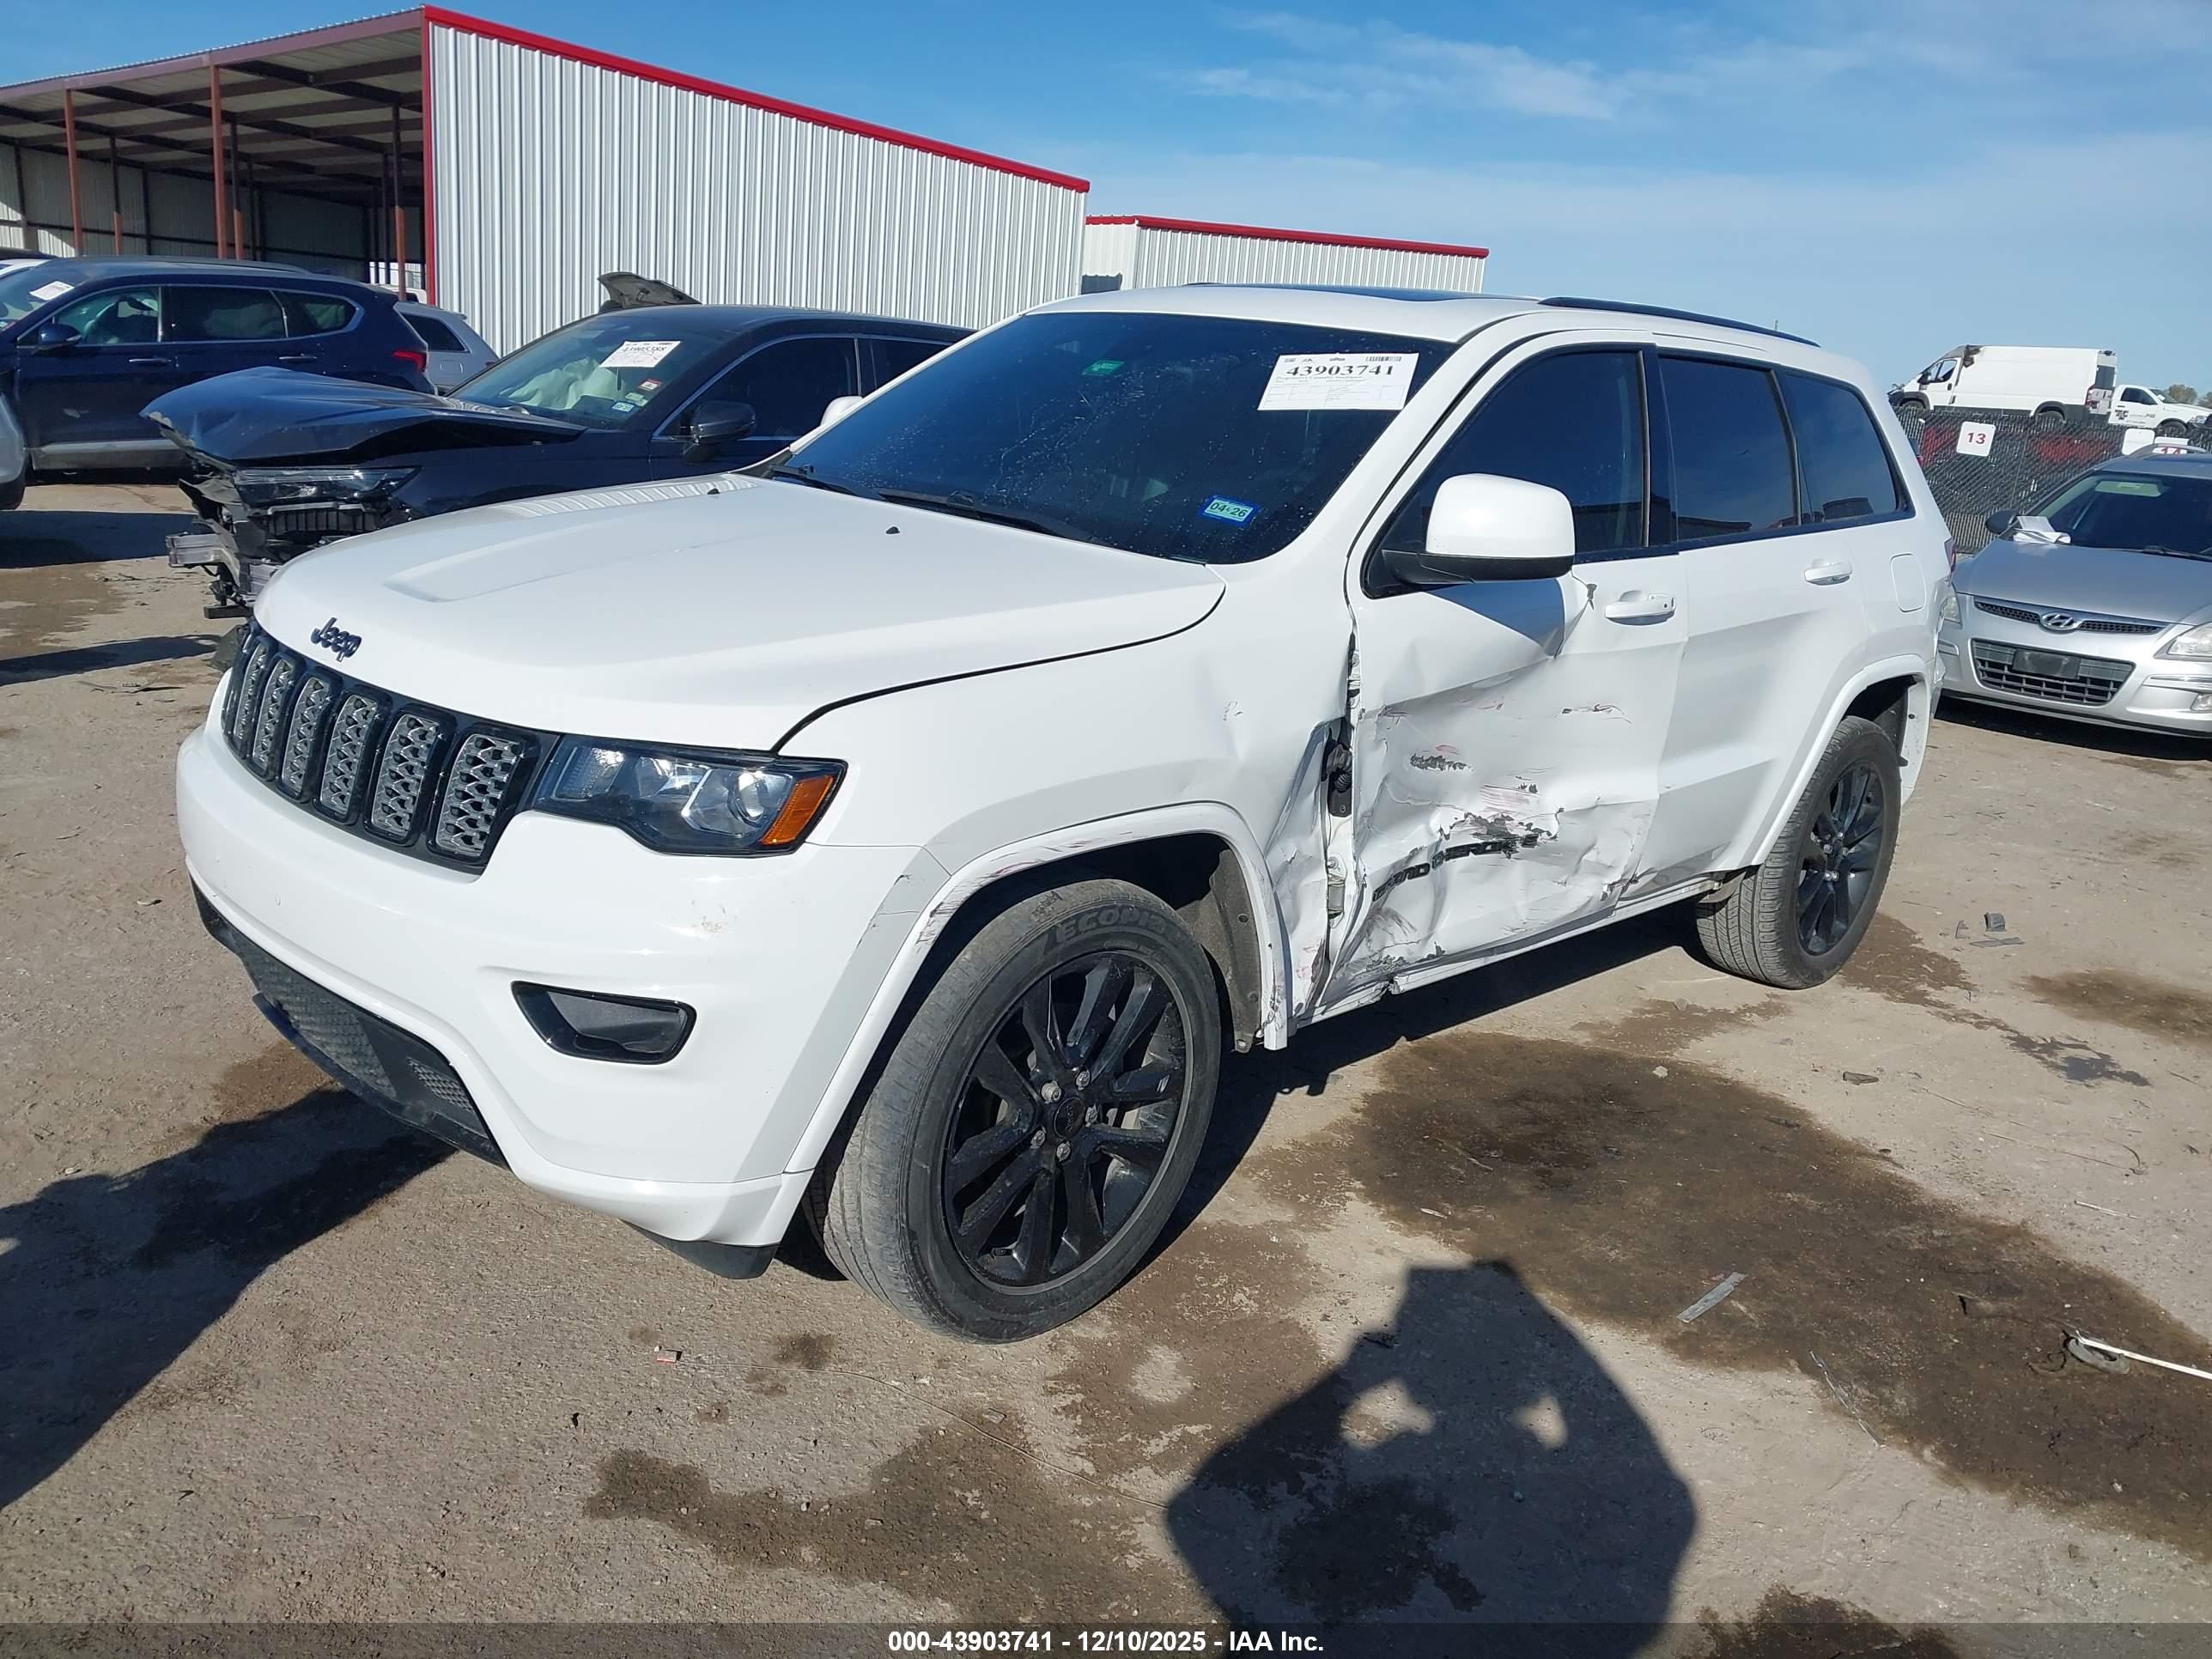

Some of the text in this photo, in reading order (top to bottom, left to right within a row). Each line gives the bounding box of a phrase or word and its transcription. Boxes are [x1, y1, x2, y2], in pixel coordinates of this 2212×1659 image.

[1286, 365, 1393, 376] 43903741
[1967, 432, 1986, 444] 13
[311, 617, 362, 662] Jeep
